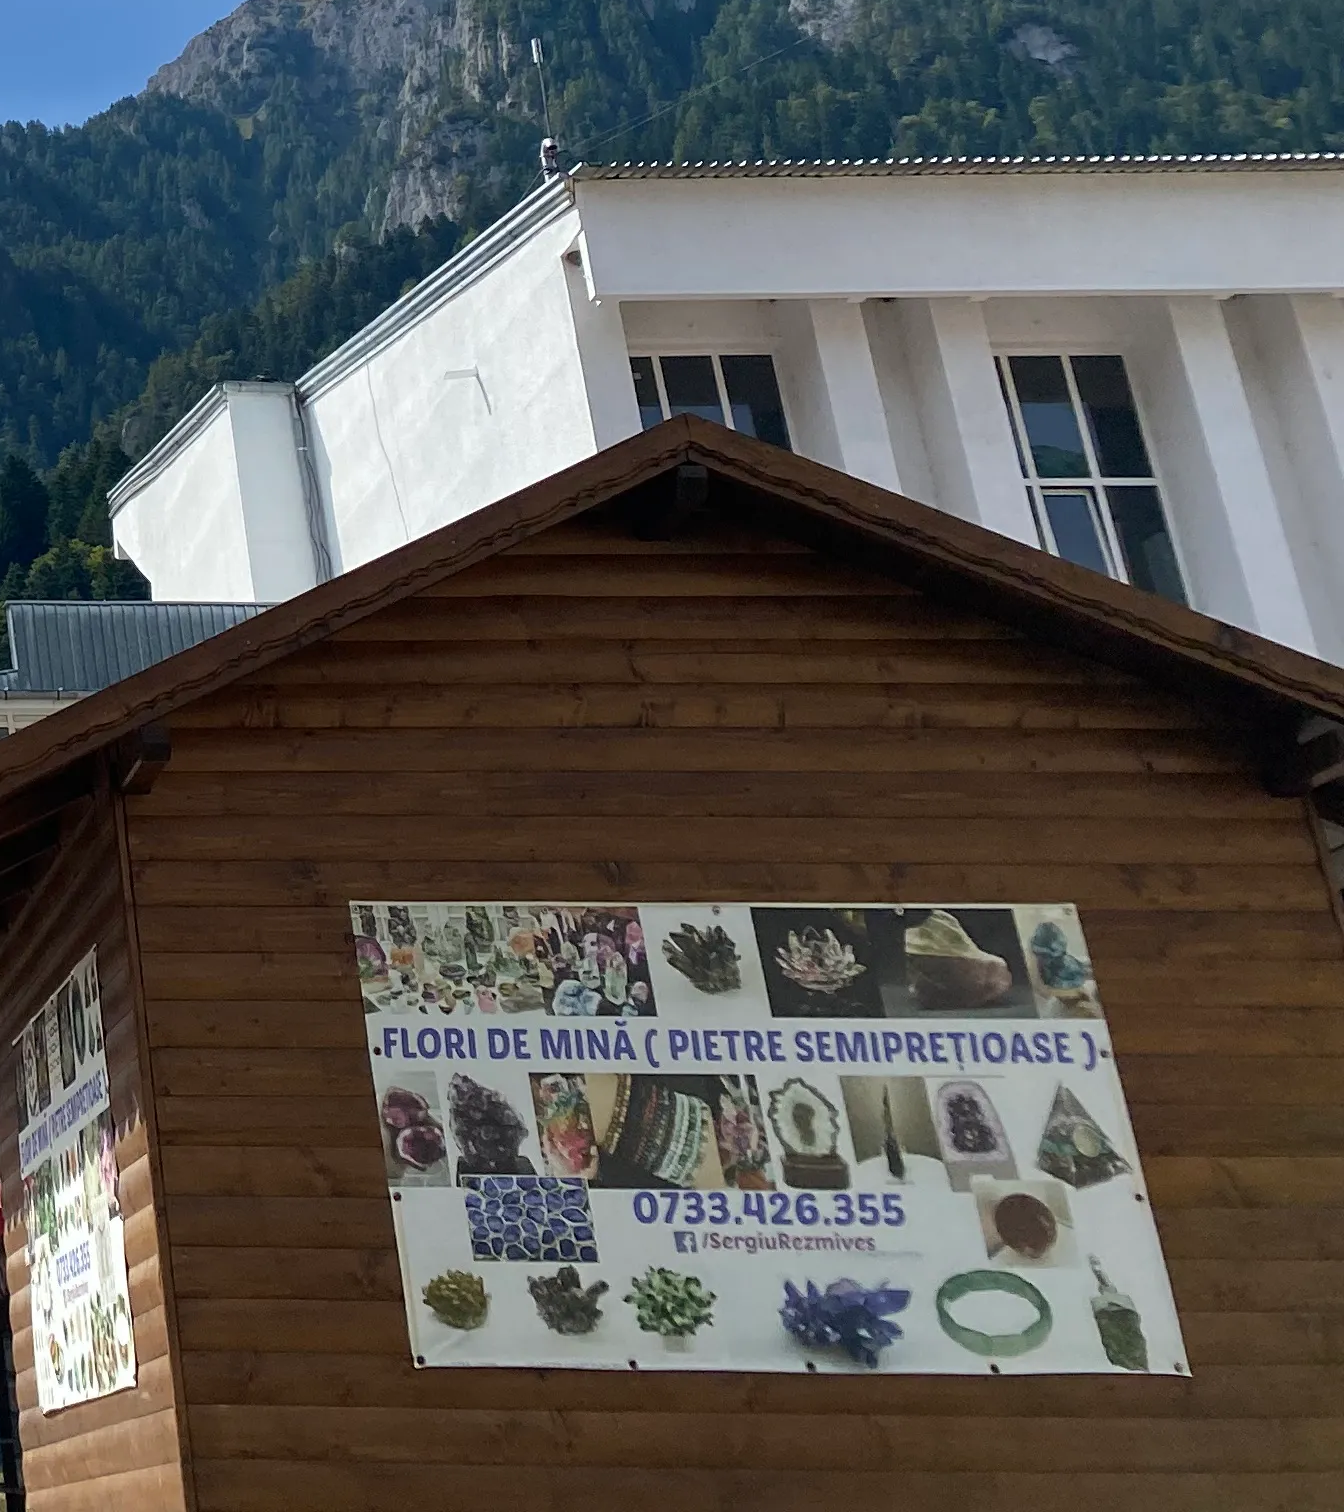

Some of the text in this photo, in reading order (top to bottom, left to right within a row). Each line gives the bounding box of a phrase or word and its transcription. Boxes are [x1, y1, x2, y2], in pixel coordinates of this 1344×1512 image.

[382, 1027, 479, 1060] FLORI
[486, 1028, 532, 1060] DE
[539, 1019, 638, 1061] MINĂ
[668, 1029, 787, 1063] PIETRE
[794, 1030, 1075, 1071] SEMIPREȚIOASE
[632, 1191, 906, 1227] 0733.426.355
